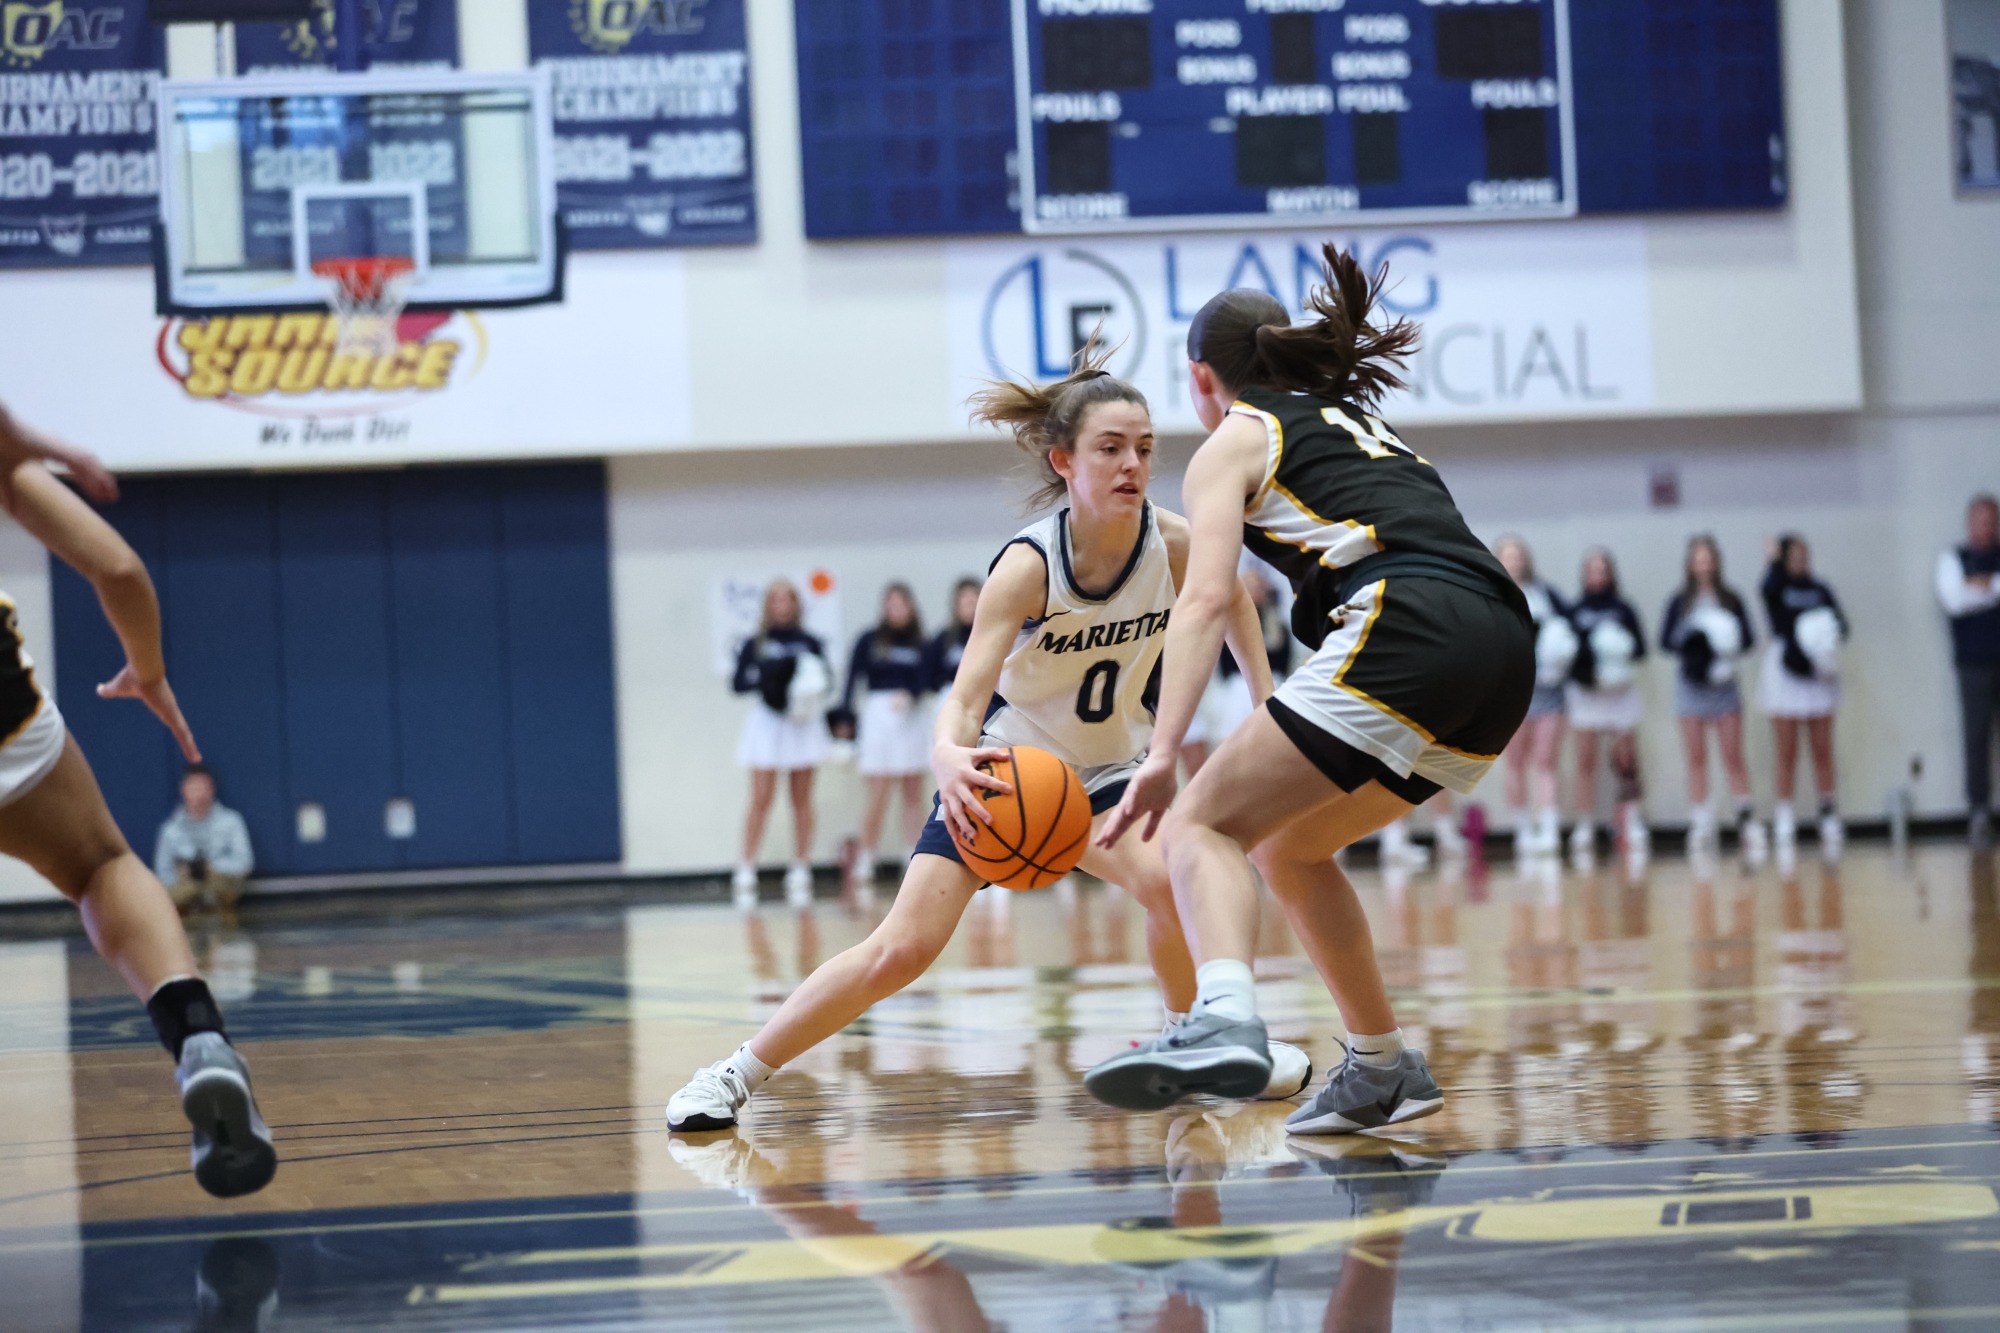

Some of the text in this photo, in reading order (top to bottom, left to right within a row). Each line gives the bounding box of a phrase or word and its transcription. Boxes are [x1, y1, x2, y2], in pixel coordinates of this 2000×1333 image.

[13, 7, 125, 50] OAC
[1031, 91, 1121, 122] FOULS
[1225, 85, 1334, 117] PLAYER
[1471, 77, 1558, 109] FOULS
[0, 103, 152, 137] AMPIONS
[0, 152, 160, 199] 20-2021
[1165, 237, 1438, 323] LANG
[184, 339, 461, 398] SOURCE
[1166, 320, 1619, 409] FCIAL
[1037, 608, 1171, 655] MARIETTA
[1075, 658, 1121, 724] 0
